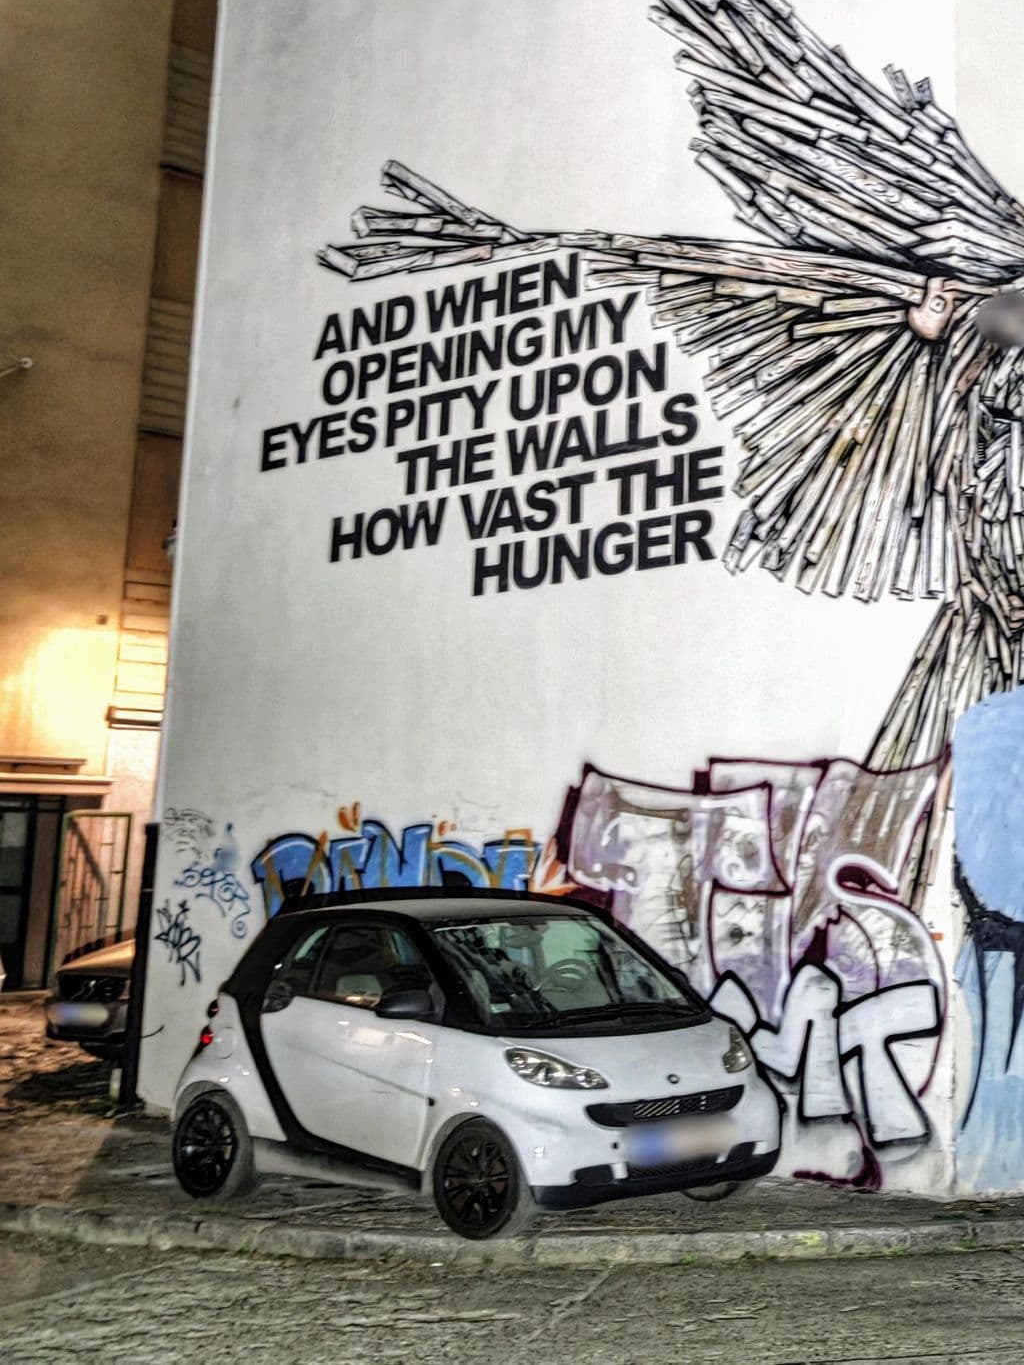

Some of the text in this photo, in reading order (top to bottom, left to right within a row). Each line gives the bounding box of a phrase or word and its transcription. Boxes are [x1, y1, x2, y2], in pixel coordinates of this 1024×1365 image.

[314, 252, 579, 360] AND WHEN
[322, 292, 641, 406] OPENING MY
[260, 342, 667, 472] EYES PITY UPON
[397, 393, 698, 495] THE WALLS
[329, 446, 723, 562] HOW VAST THE
[472, 509, 716, 596] HUNGER
